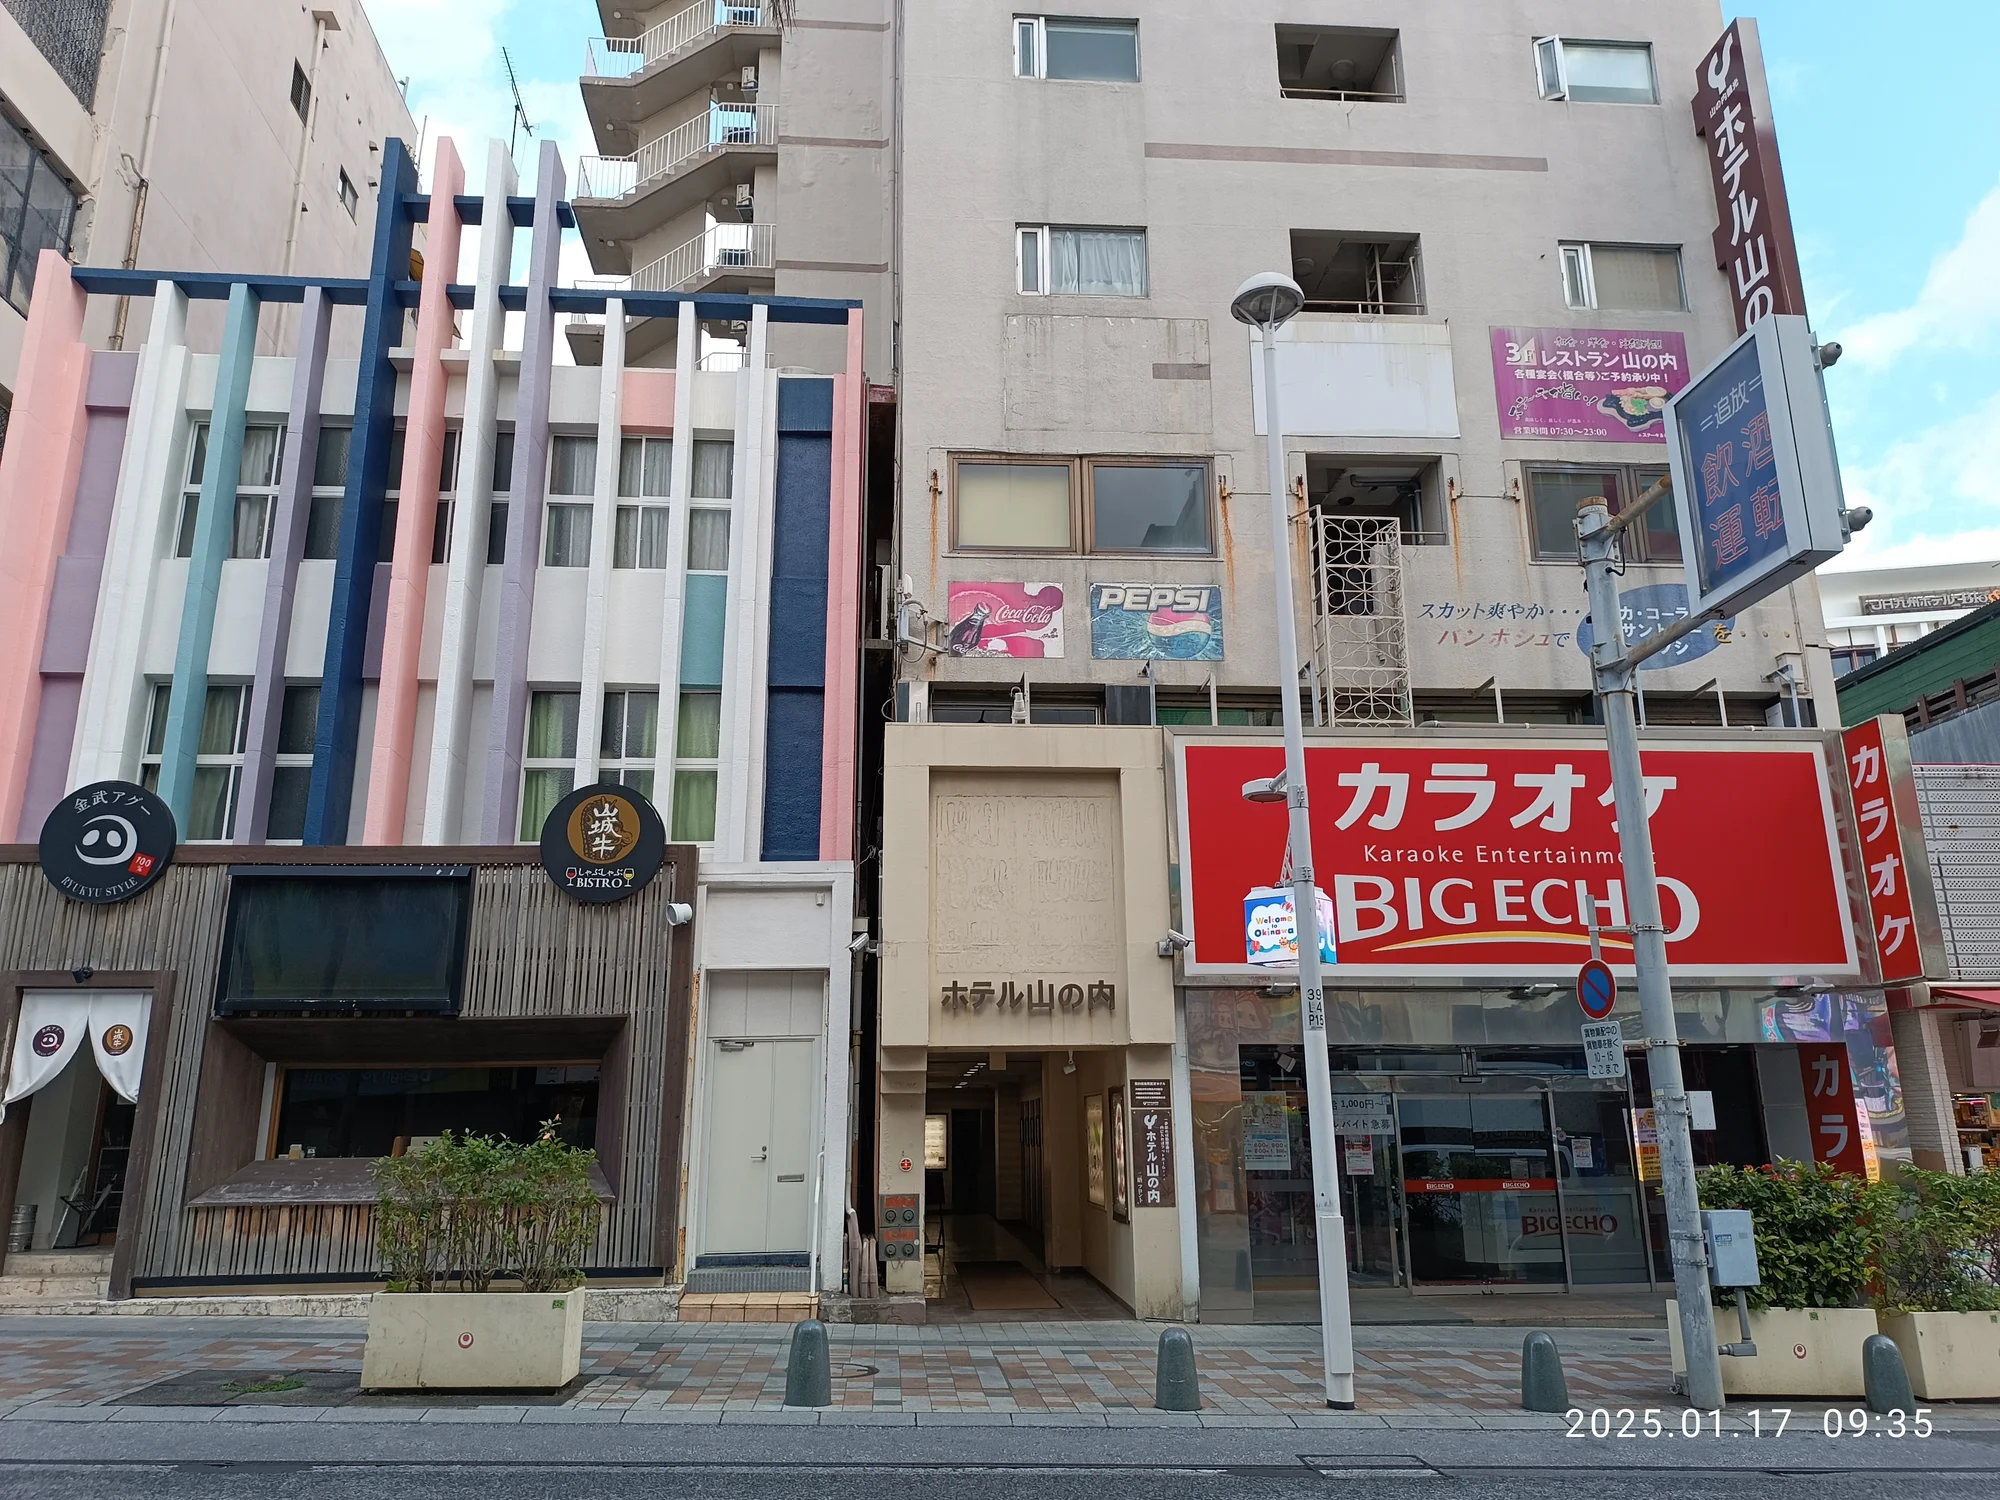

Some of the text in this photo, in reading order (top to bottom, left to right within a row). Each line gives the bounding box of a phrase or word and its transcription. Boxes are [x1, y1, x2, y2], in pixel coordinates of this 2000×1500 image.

[1541, 351, 1678, 371] レストラン山の内
[1513, 426, 1548, 436] 営業時間
[1097, 587, 1212, 612] PEPSI
[994, 604, 1053, 625] Coca-Cola
[74, 790, 151, 815] 金武アグー
[1334, 762, 1677, 834] カラオケ
[588, 803, 623, 859] 山城牛
[1363, 844, 1657, 865] Karaoke Entertainm
[1852, 745, 1911, 956] カラオケ
[578, 867, 624, 877] しゃぶしゃぶ
[60, 875, 138, 898] RYUKYU STYLE
[576, 877, 623, 889] BISTRO
[1333, 873, 1478, 944] BIG
[1492, 877, 1701, 943] ECHO
[1255, 914, 1293, 925] Welcome
[1254, 927, 1294, 938] Okinawa
[940, 979, 1116, 1012] ホテル山の内
[1307, 988, 1322, 1001] 39
[1308, 1001, 1323, 1013] L 4
[1592, 1063, 1619, 1075] ここまで
[1146, 1131, 1161, 1204] ホテル山の内
[1521, 1214, 1618, 1235] BIG ECHO
